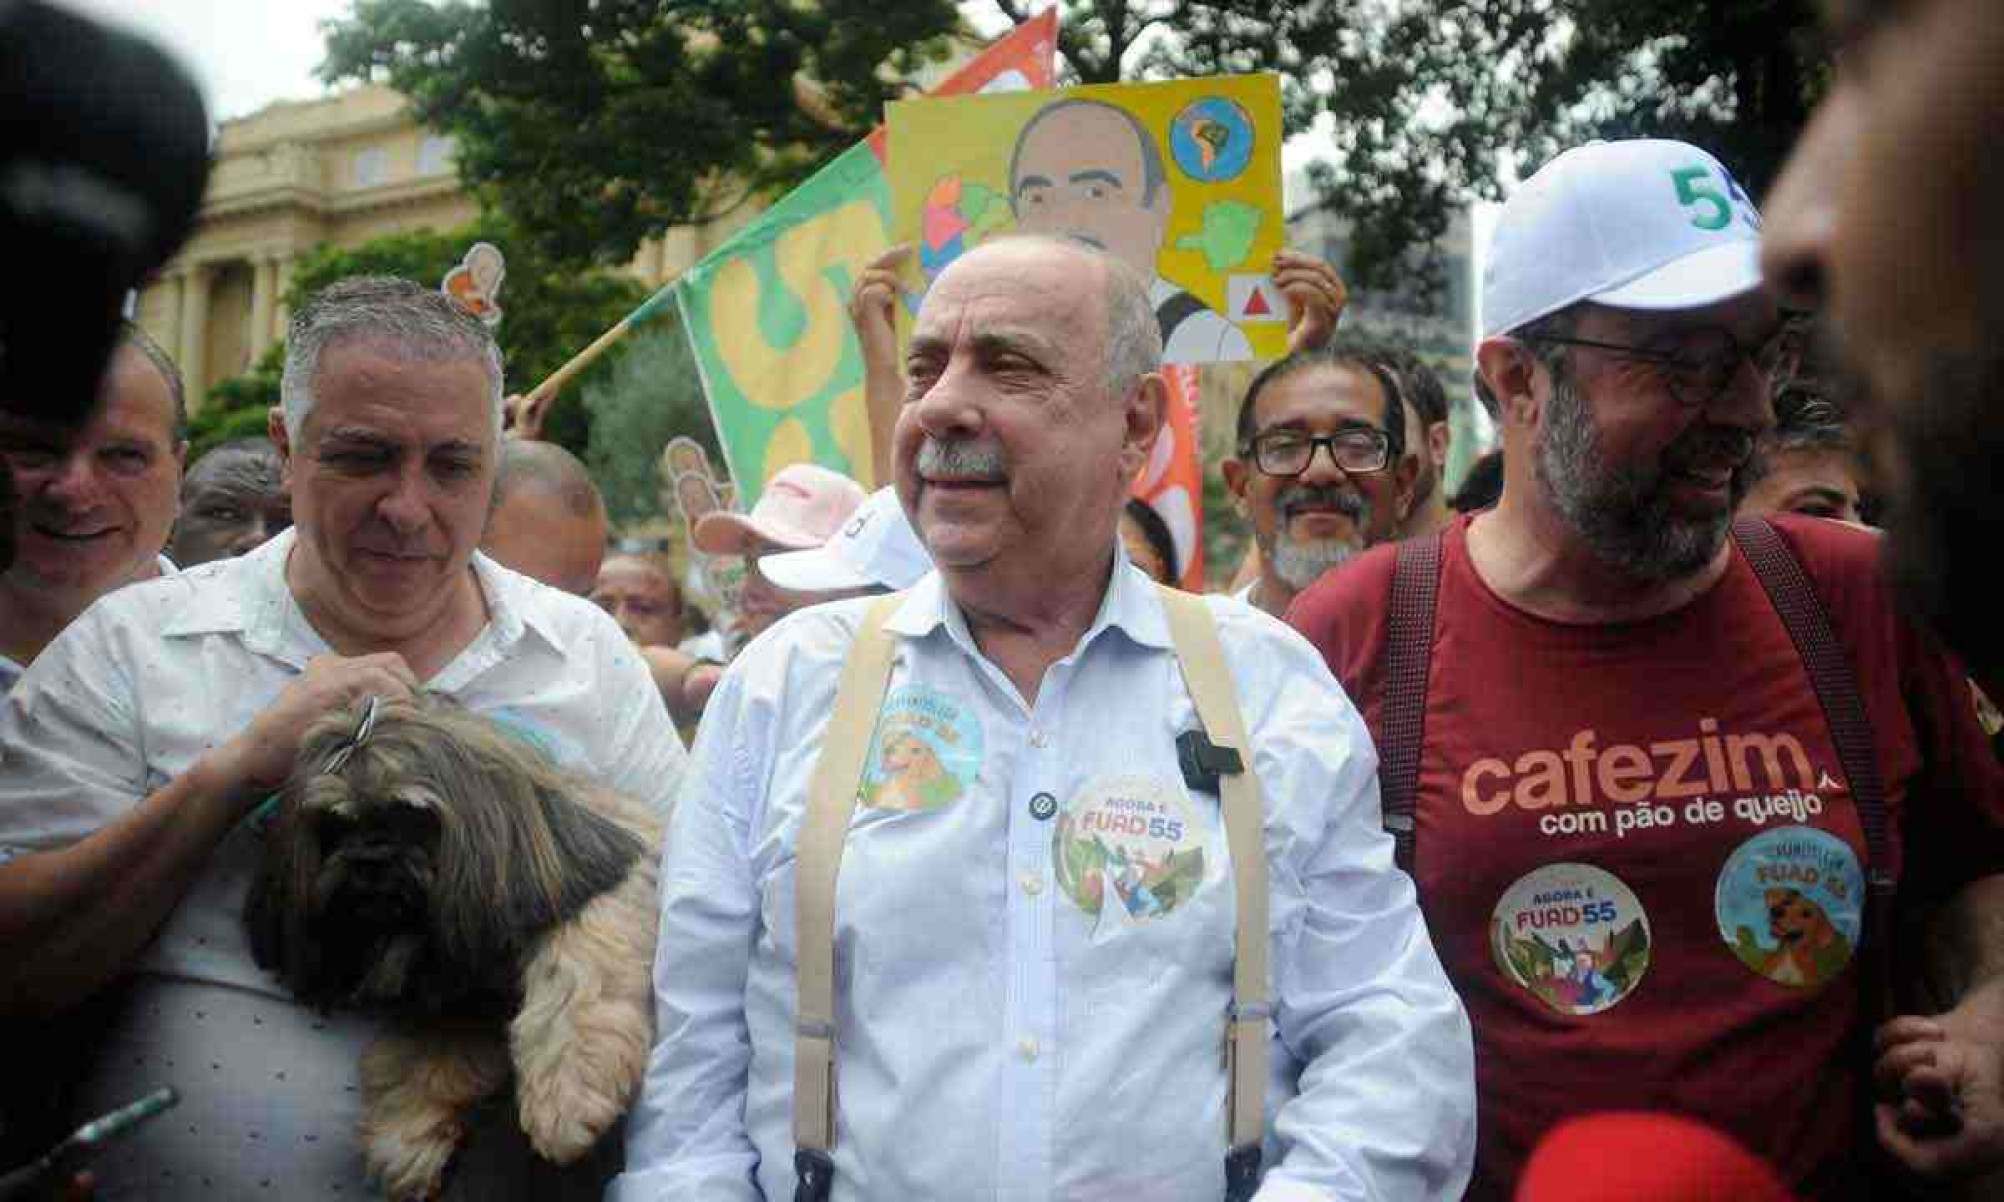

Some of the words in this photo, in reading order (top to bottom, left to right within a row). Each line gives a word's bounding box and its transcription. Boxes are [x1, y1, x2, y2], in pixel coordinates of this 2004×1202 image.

[1462, 717, 1815, 816] cafezim
[1540, 808, 1608, 836] com
[1615, 800, 1675, 838] pão
[1684, 797, 1724, 824] de
[1734, 788, 1822, 825] queijo
[1516, 904, 1580, 932] FUAD
[1582, 900, 1617, 924] 55
